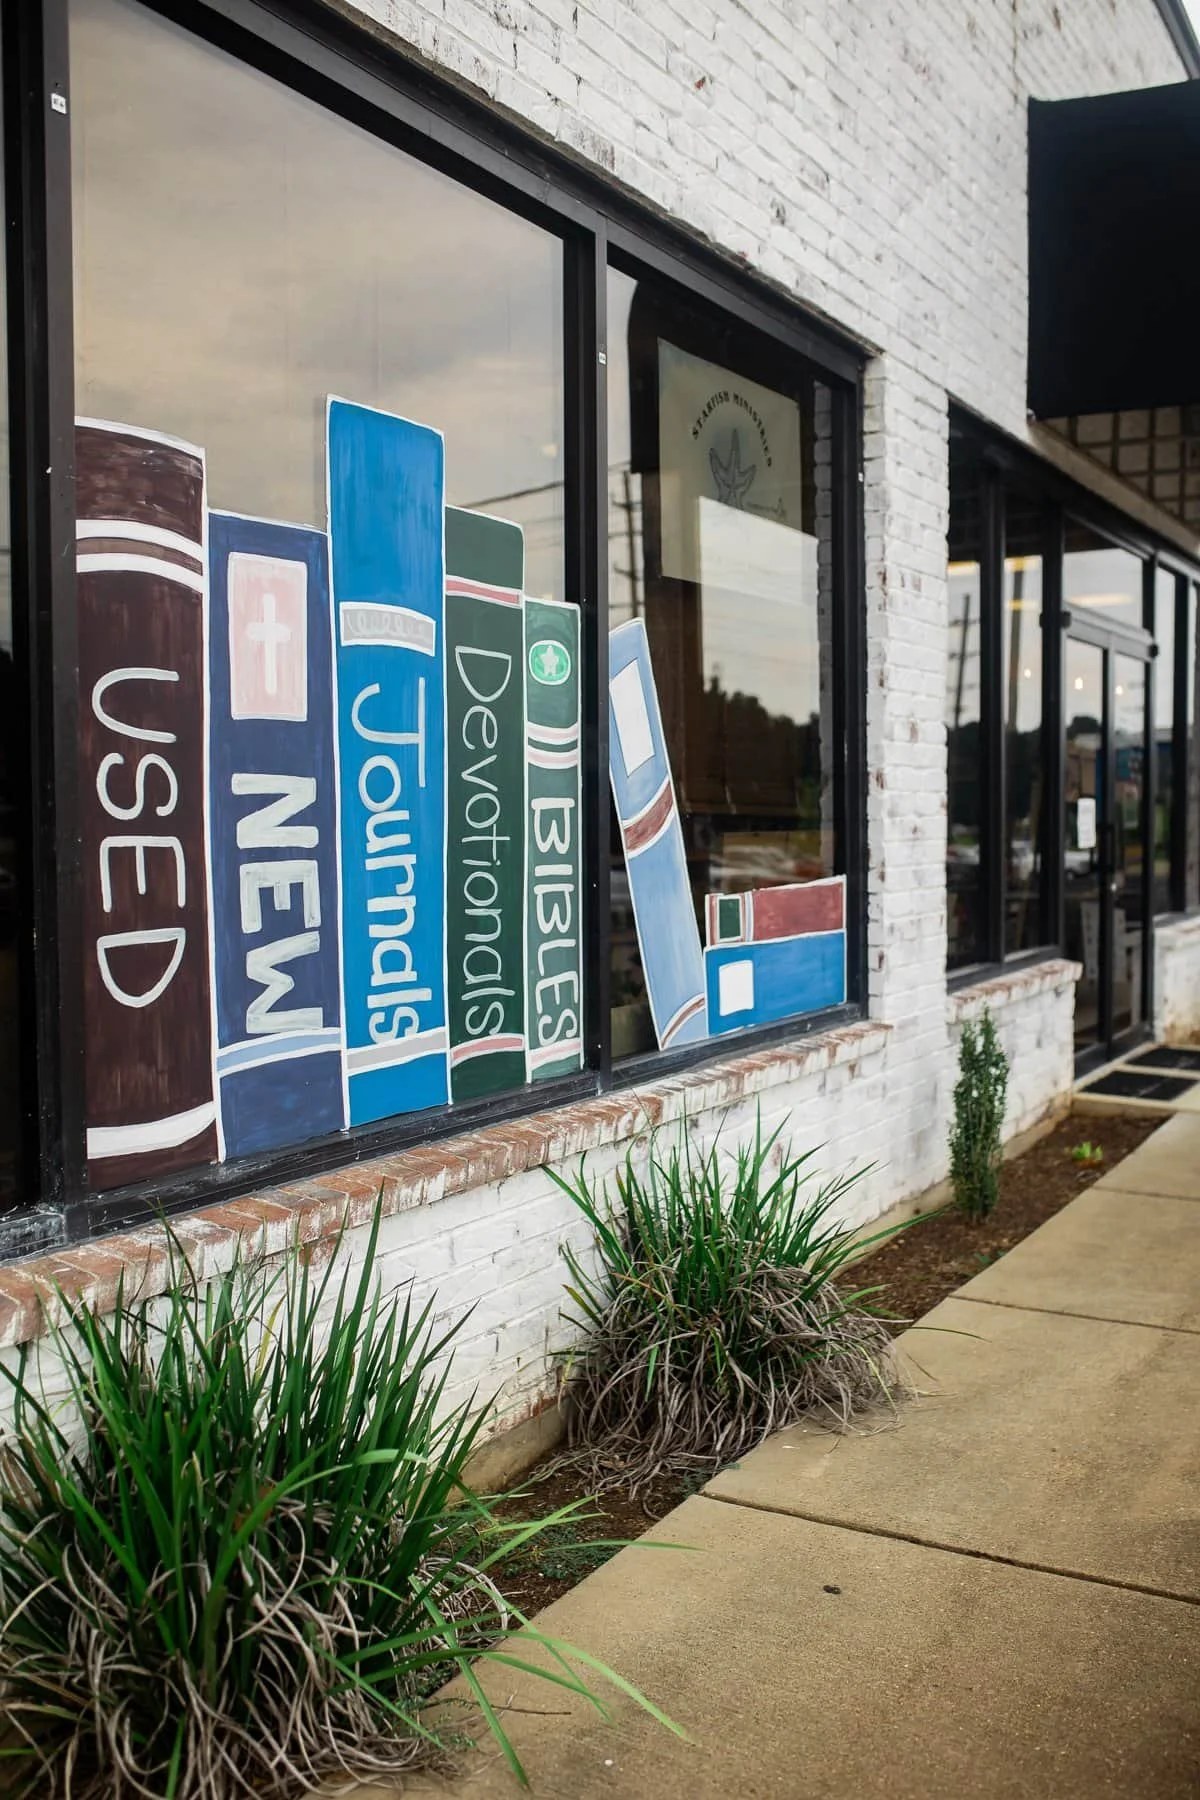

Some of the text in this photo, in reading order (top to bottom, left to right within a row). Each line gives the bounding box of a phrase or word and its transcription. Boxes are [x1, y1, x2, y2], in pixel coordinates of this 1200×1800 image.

[692, 391, 772, 467] STARFISH MINISTRIES
[92, 668, 186, 1008] USED
[231, 773, 323, 1034] NEW
[351, 677, 432, 1044] Journals
[454, 645, 515, 1036] Devotionals
[530, 796, 579, 1046] BIBLES
